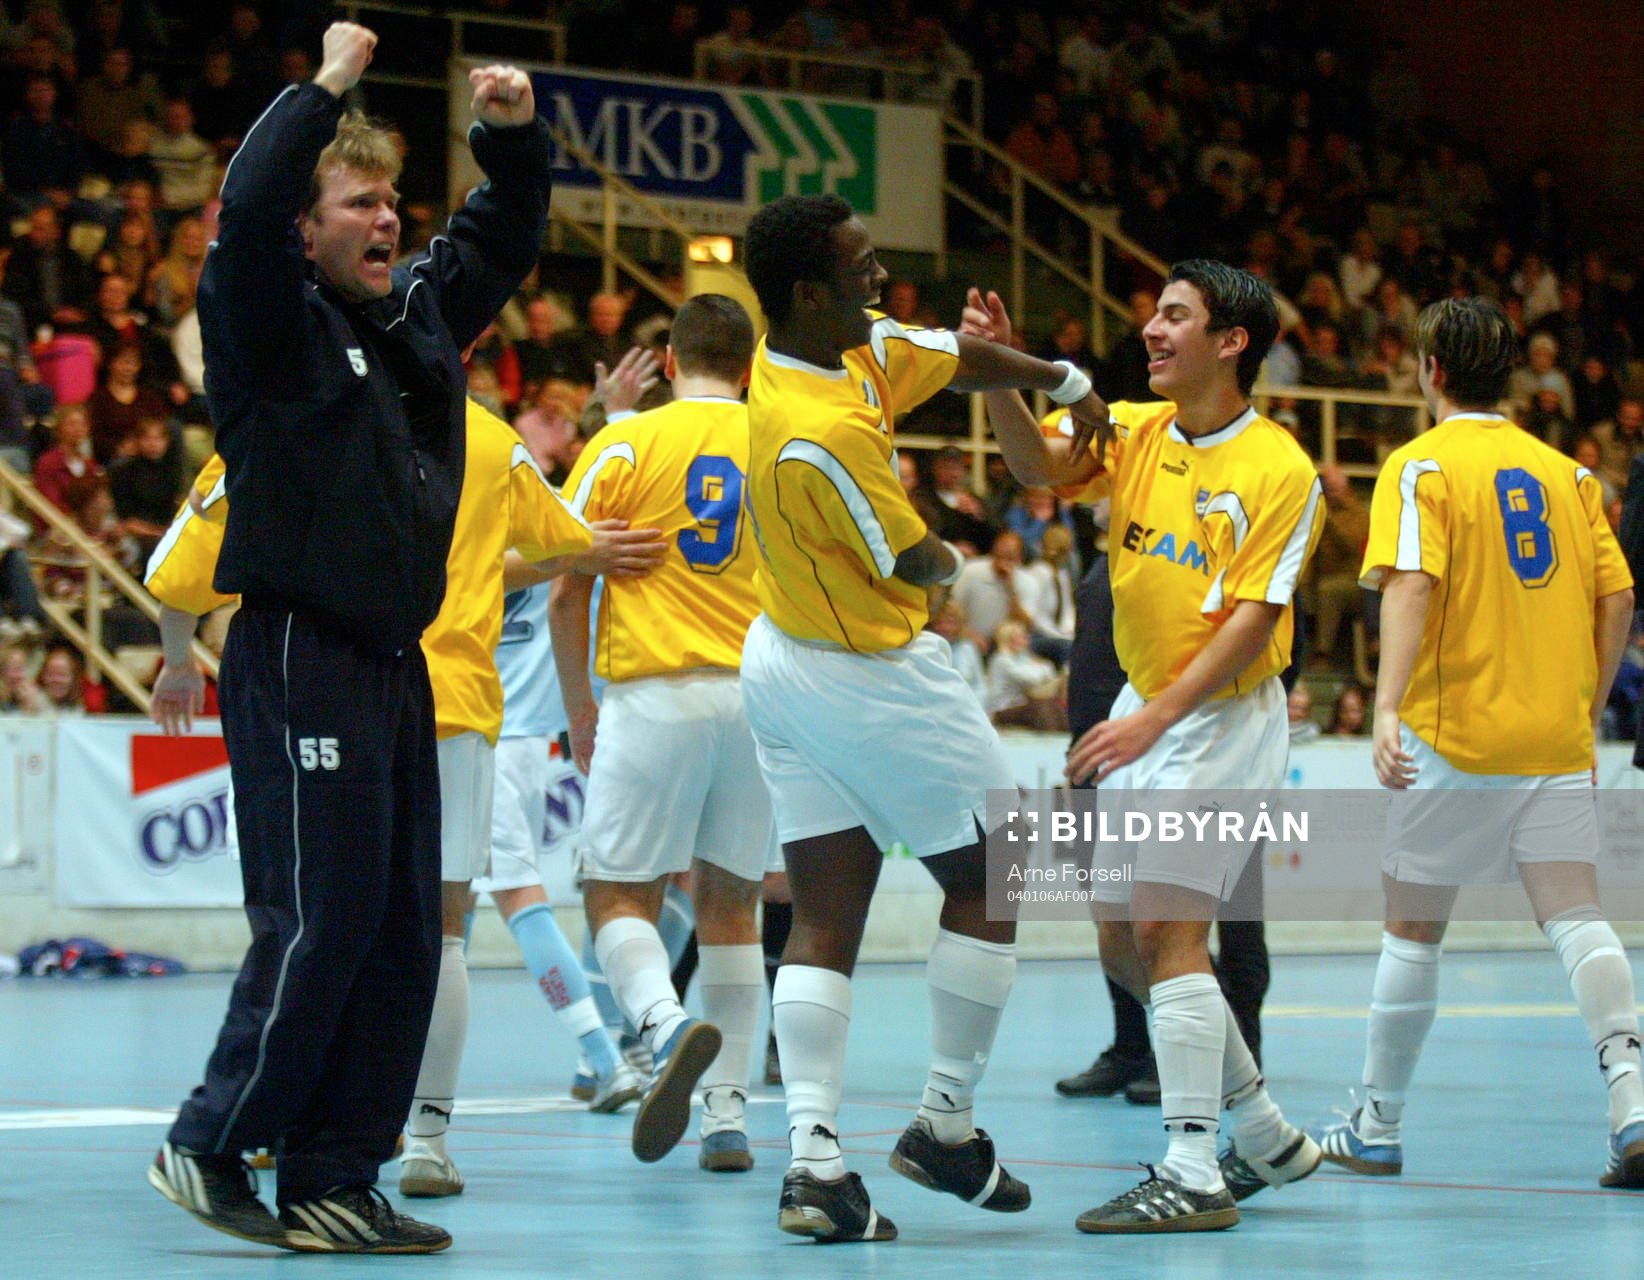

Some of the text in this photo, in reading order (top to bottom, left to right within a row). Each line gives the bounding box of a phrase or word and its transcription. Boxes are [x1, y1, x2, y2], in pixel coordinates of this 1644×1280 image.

[549, 90, 724, 183] MKB
[346, 348, 369, 377] 5
[677, 454, 746, 576] 9
[1493, 467, 1560, 589] 8
[298, 737, 341, 771] 55
